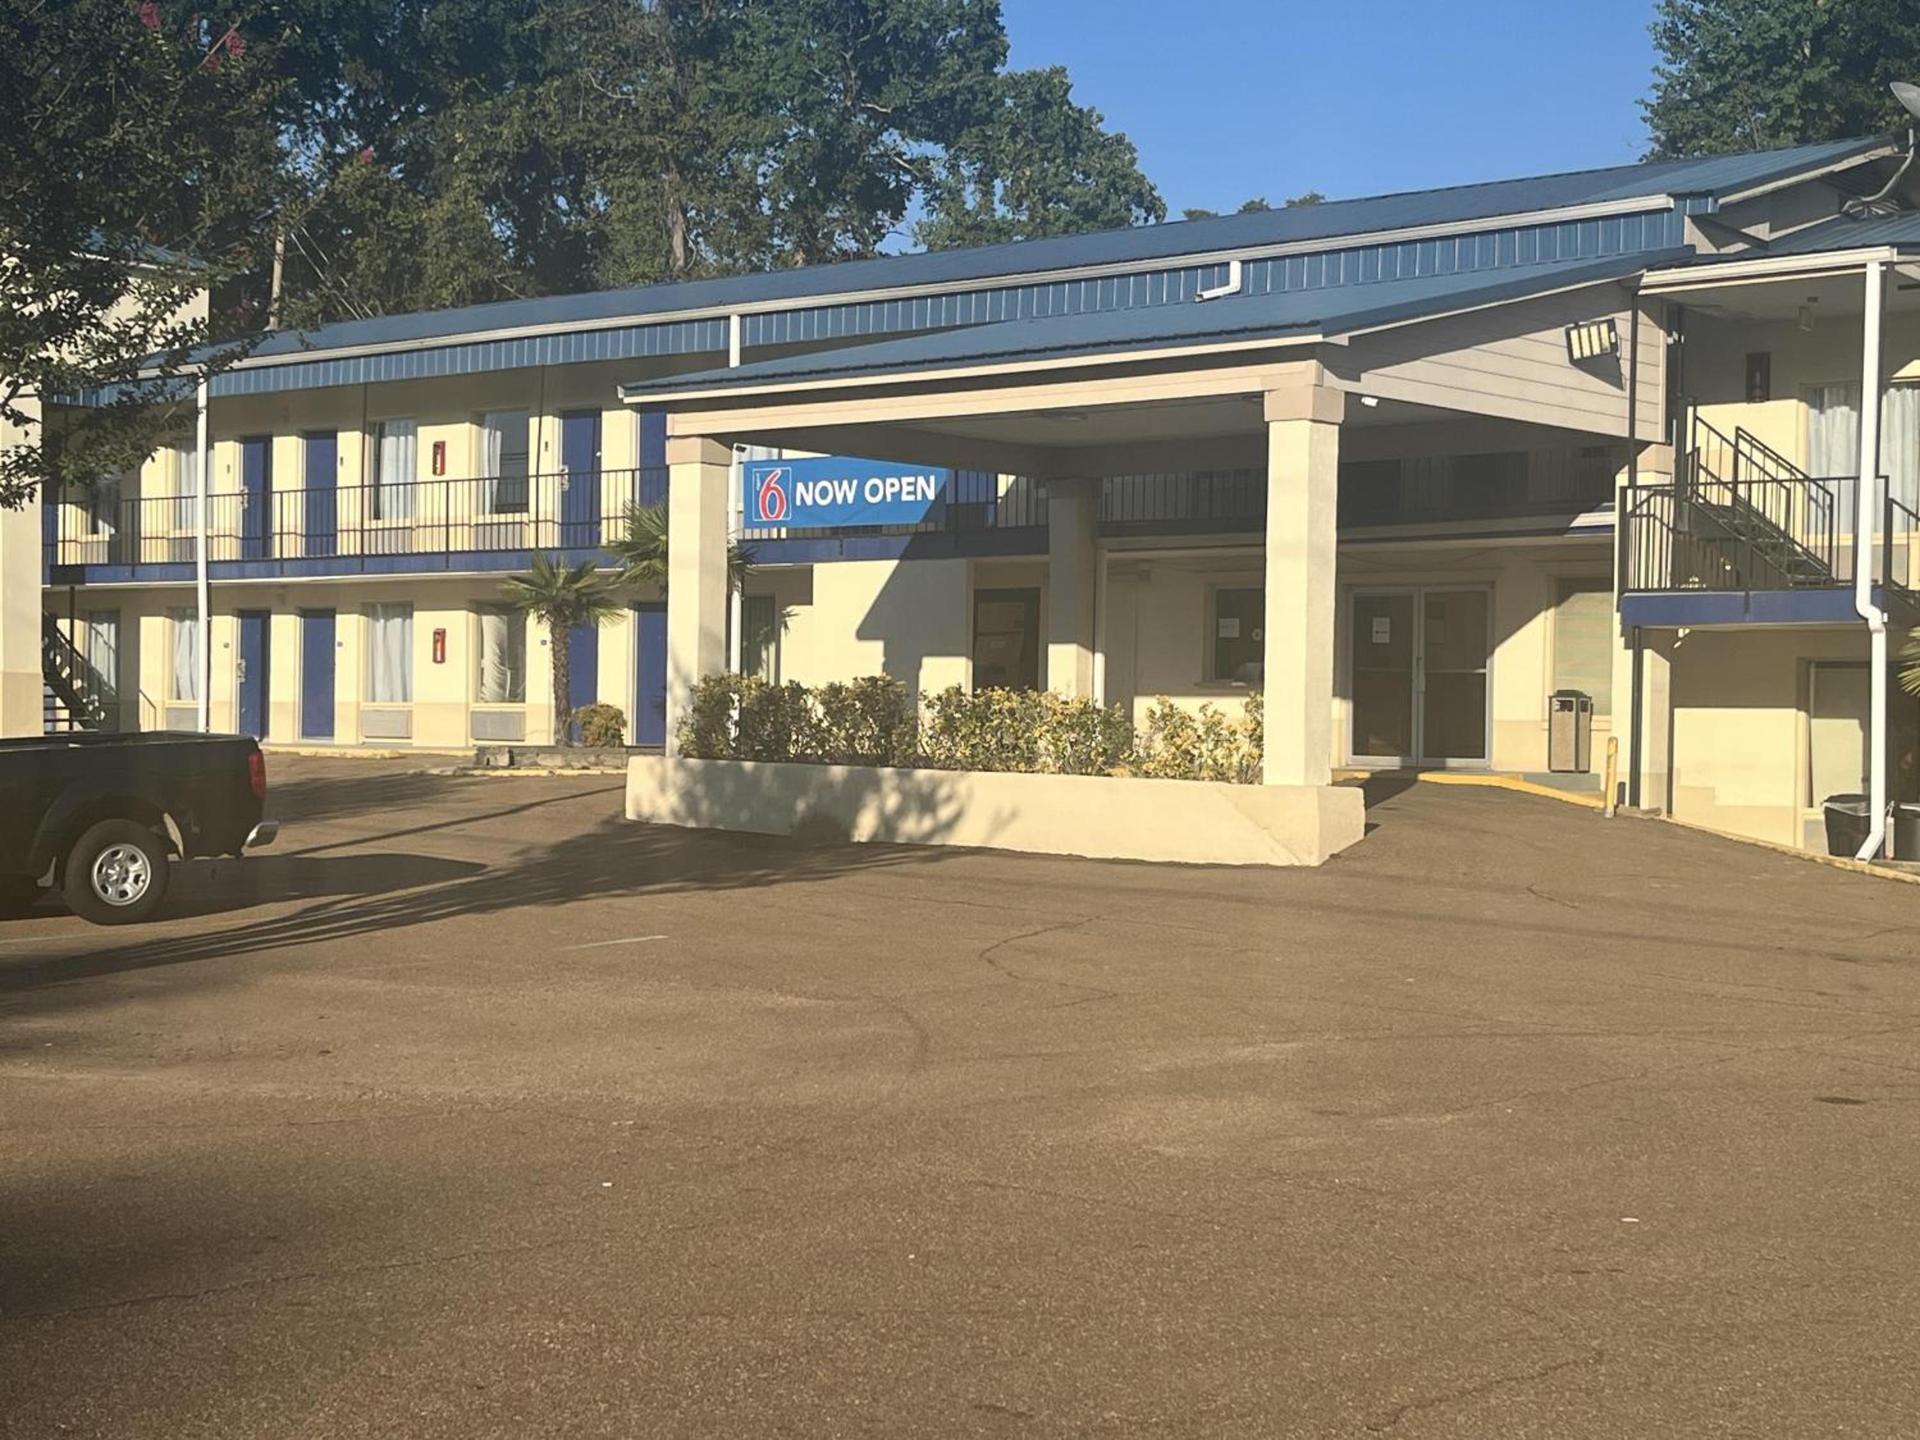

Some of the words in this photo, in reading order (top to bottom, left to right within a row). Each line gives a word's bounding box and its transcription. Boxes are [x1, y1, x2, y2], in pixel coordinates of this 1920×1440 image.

[759, 468, 786, 521] 6
[795, 479, 858, 506] NOW
[864, 475, 935, 503] OPEN
